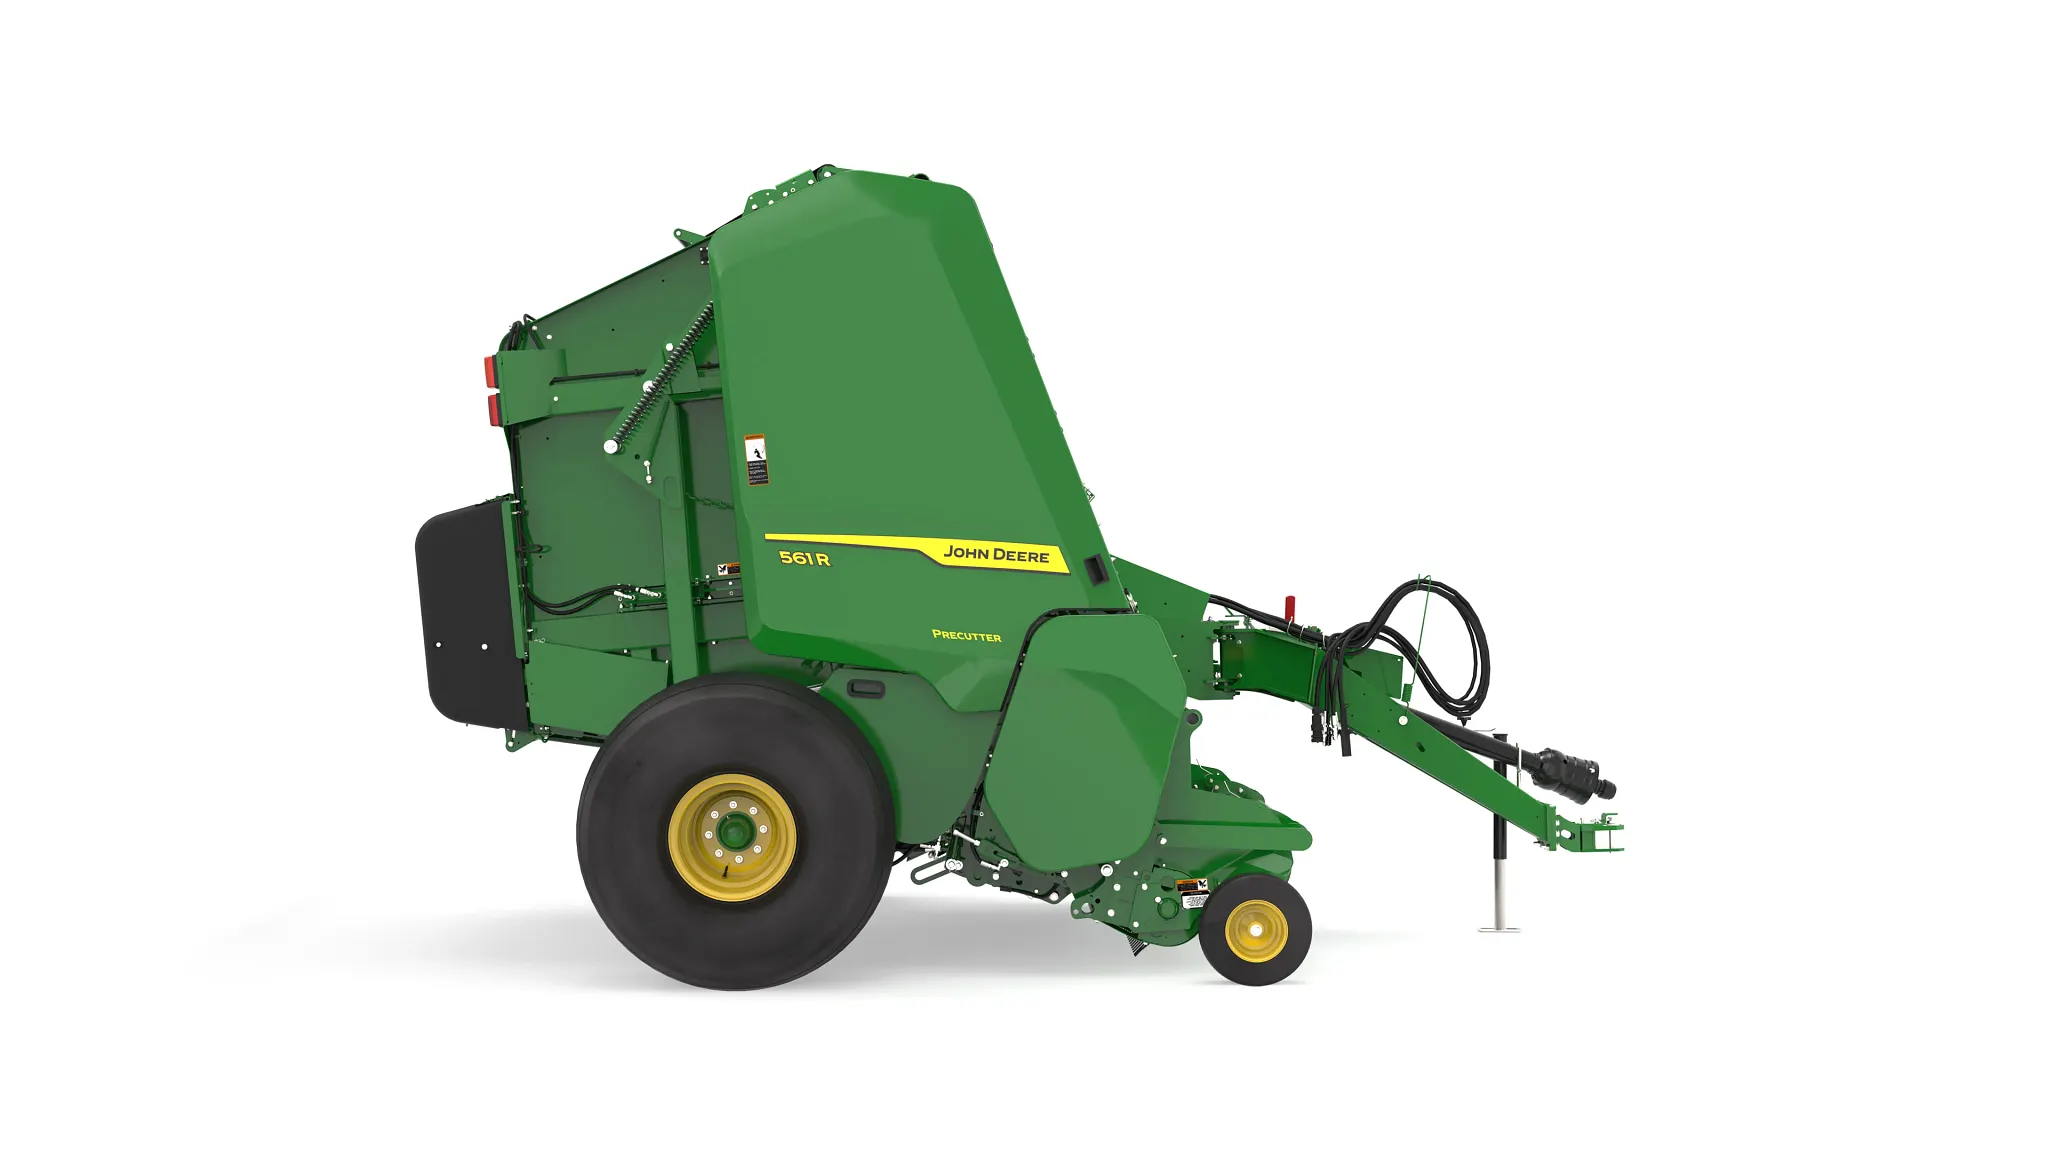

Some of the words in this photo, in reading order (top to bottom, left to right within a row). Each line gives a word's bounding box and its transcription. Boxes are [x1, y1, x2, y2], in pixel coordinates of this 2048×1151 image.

[943, 545, 989, 560] JOHN
[993, 547, 1050, 563] DEERE
[931, 628, 1003, 643] PRECUTTER
